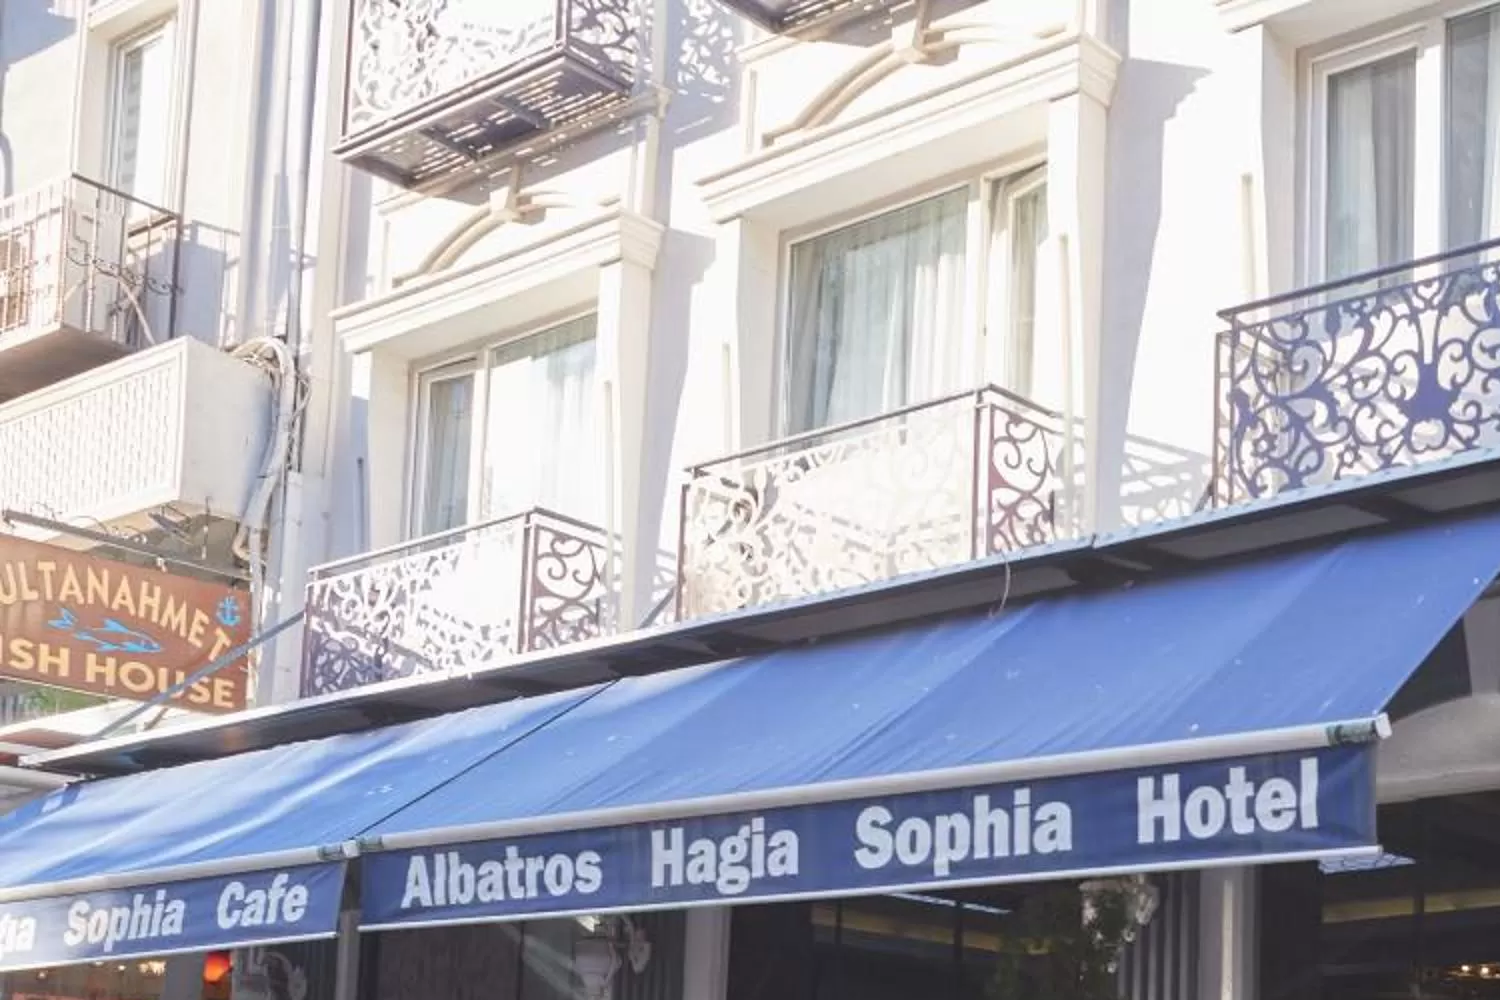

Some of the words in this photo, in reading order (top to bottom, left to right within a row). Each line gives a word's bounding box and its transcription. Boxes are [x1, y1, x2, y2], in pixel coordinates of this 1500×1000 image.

[85, 653, 236, 708] HOUSE
[400, 845, 602, 909] Albatros
[650, 817, 799, 895] Hagia
[854, 788, 1072, 877] Sophia
[1137, 757, 1319, 845] Hotel
[64, 889, 185, 952] Sophia
[217, 873, 308, 930] Cafe
